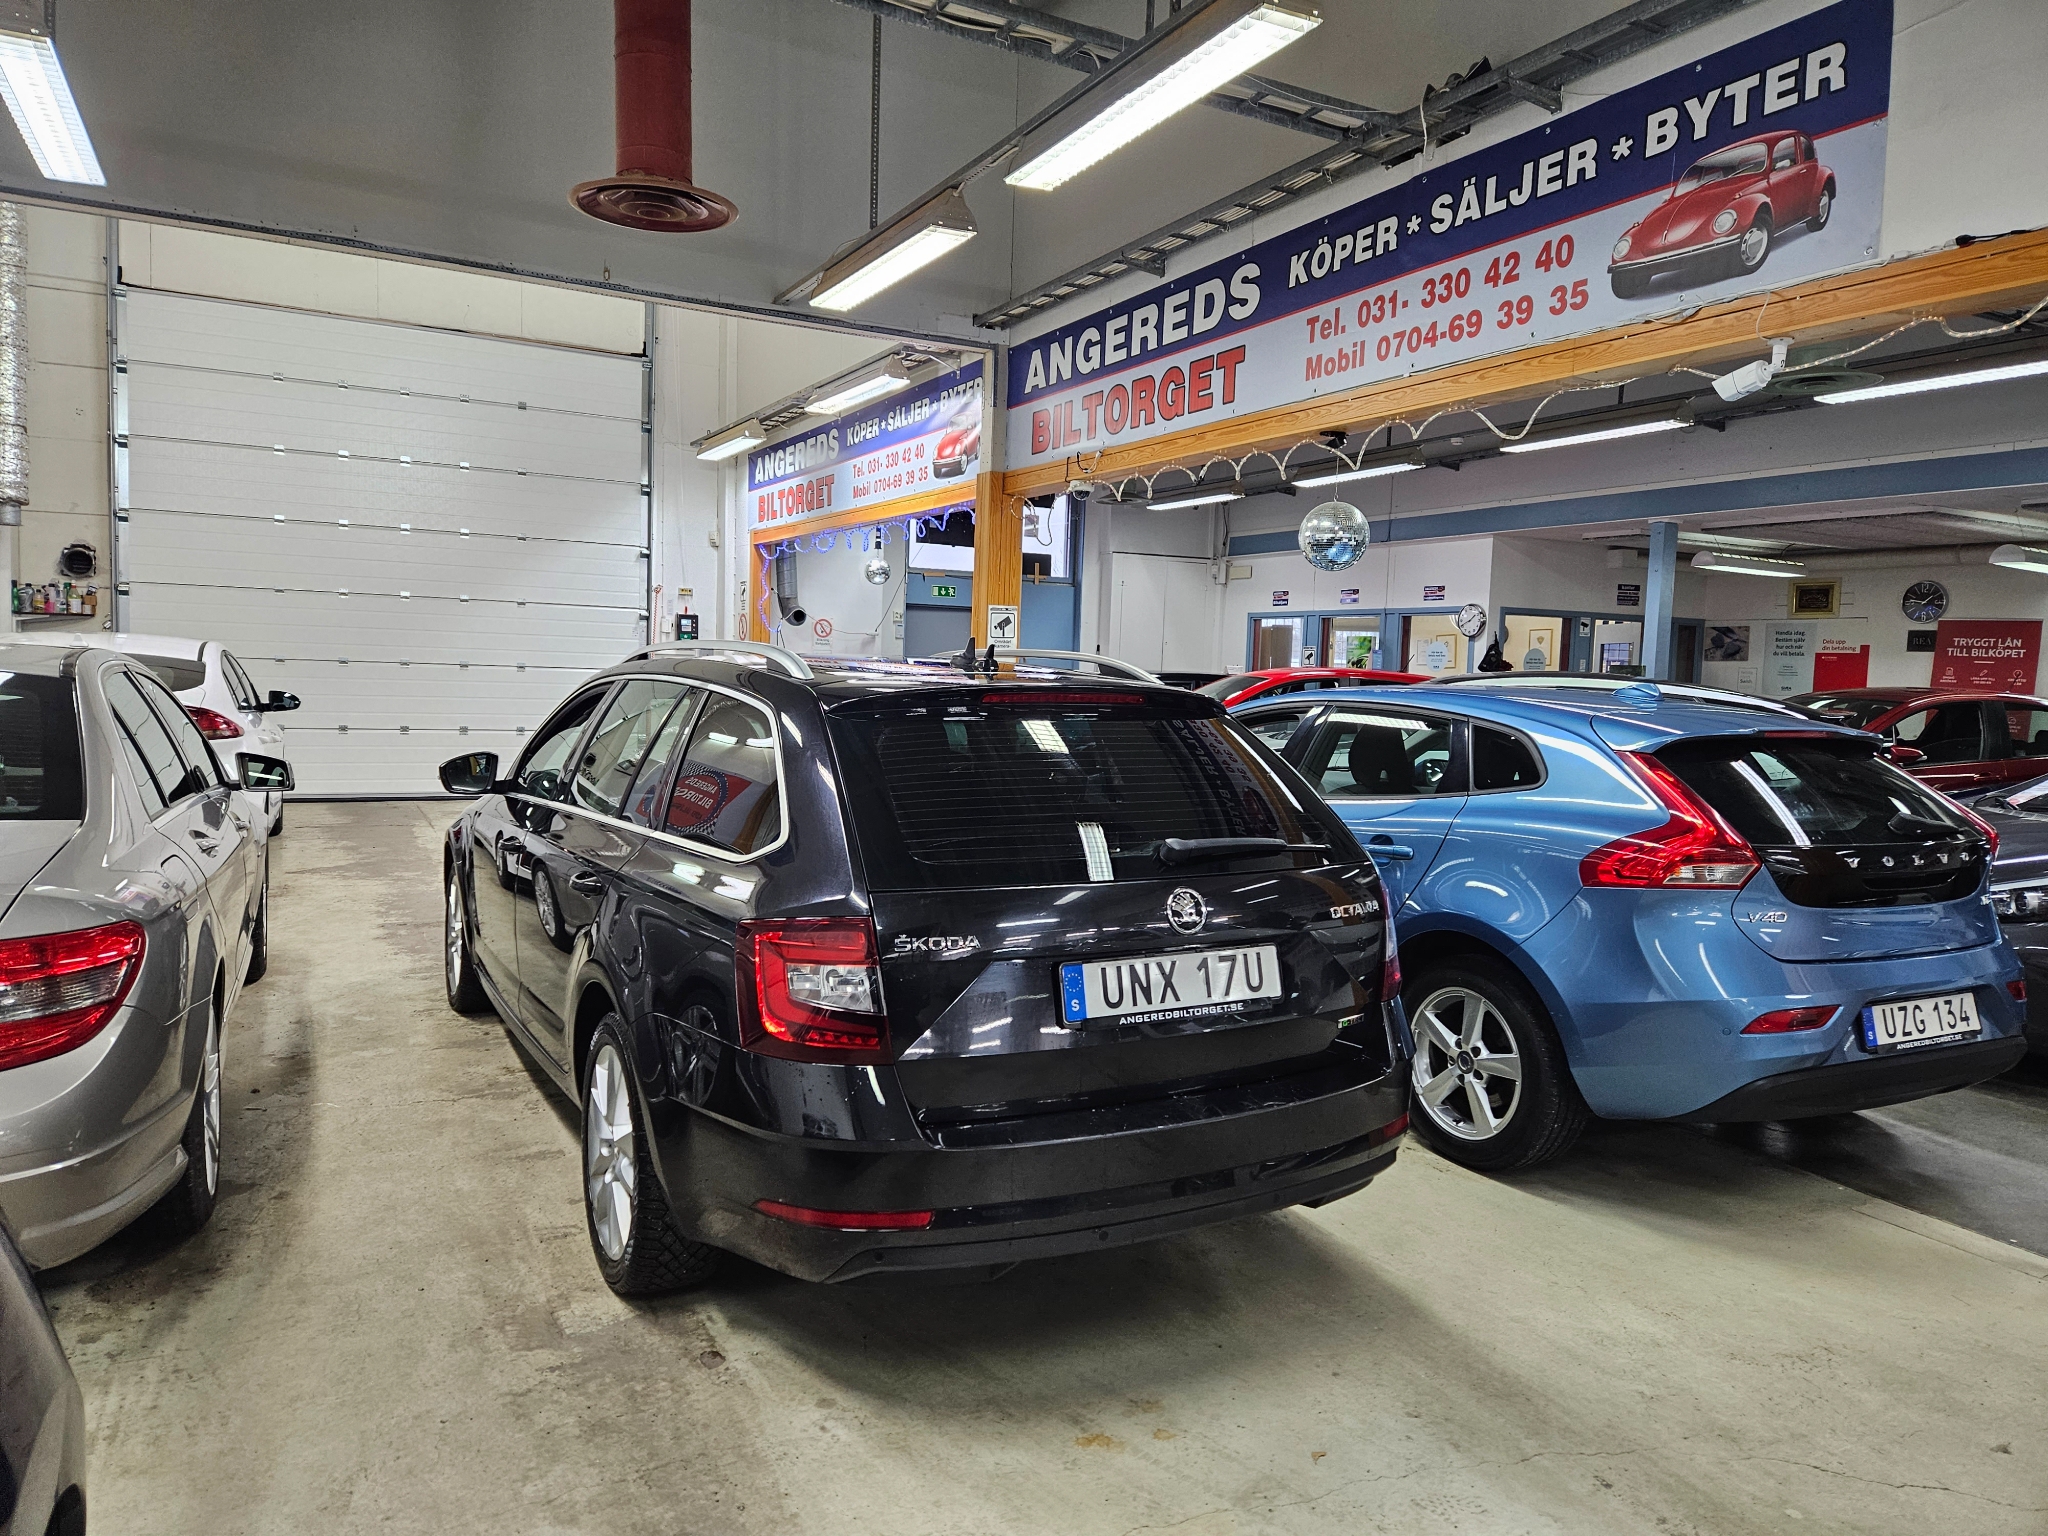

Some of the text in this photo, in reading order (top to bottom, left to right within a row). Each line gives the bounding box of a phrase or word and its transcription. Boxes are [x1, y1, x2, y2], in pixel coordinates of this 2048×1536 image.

[1288, 42, 1847, 288] KÖPER SÄLJER BYTER
[1307, 234, 1574, 344] Tel. 031- 330 42 40
[1024, 262, 1261, 394] ANGEREDS
[1305, 278, 1589, 382] Mobil 0704-69 39 35
[1031, 345, 1246, 455] BILTORGET
[847, 418, 879, 447] KÖPER
[887, 398, 930, 432] SÄLJER
[754, 427, 840, 485] ANGEREDS
[852, 443, 925, 479] Tel. 031- 330 42 40
[758, 474, 835, 523] BILTORGET
[852, 466, 928, 499] Mobil 0704-69 39 35
[1947, 646, 2026, 658] TILL BILKÖPET
[1953, 636, 2022, 648] TRYGGT LÅN
[1843, 852, 1970, 868] VOLVO
[1747, 910, 1788, 923] V40
[894, 934, 981, 952] ŠKODA
[1101, 952, 1264, 1010] UNX 17U
[1071, 998, 1080, 1011] S
[1119, 1002, 1244, 1025] ANGEREDBILTORGET.SE
[1882, 997, 1971, 1039] UZG 134
[1867, 1031, 1874, 1040] S
